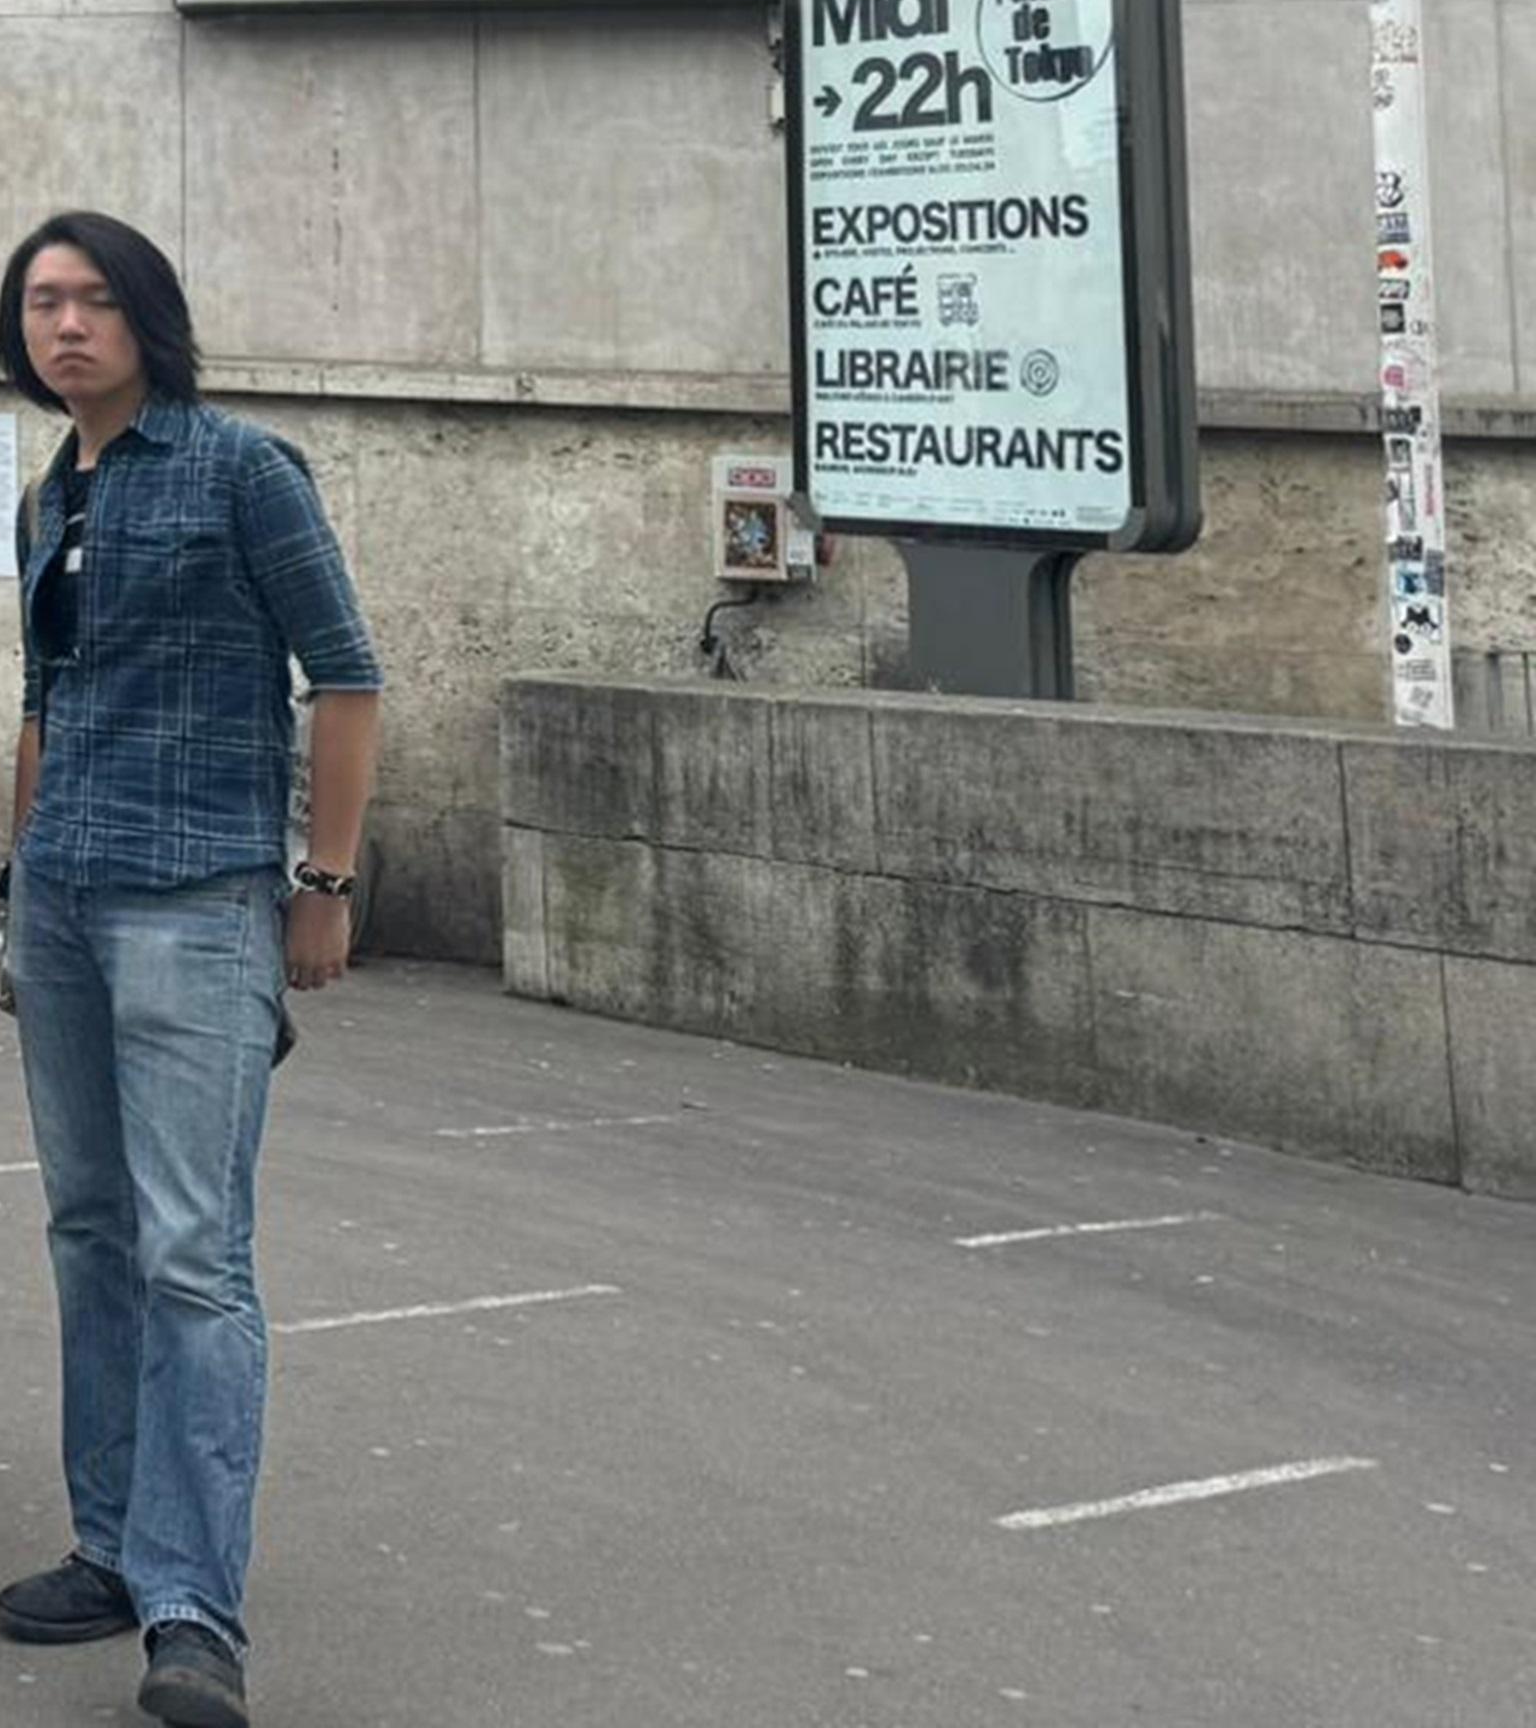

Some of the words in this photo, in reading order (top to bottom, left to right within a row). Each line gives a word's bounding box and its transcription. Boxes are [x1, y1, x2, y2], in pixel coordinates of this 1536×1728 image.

[1013, 2, 1051, 42] de
[852, 50, 994, 133] 22h
[812, 194, 1090, 247] EXPOSITIONS
[813, 263, 920, 318] CAFÉ
[814, 348, 1011, 392] LIBRAIRIE
[814, 420, 1124, 474] RESTAURANTS
